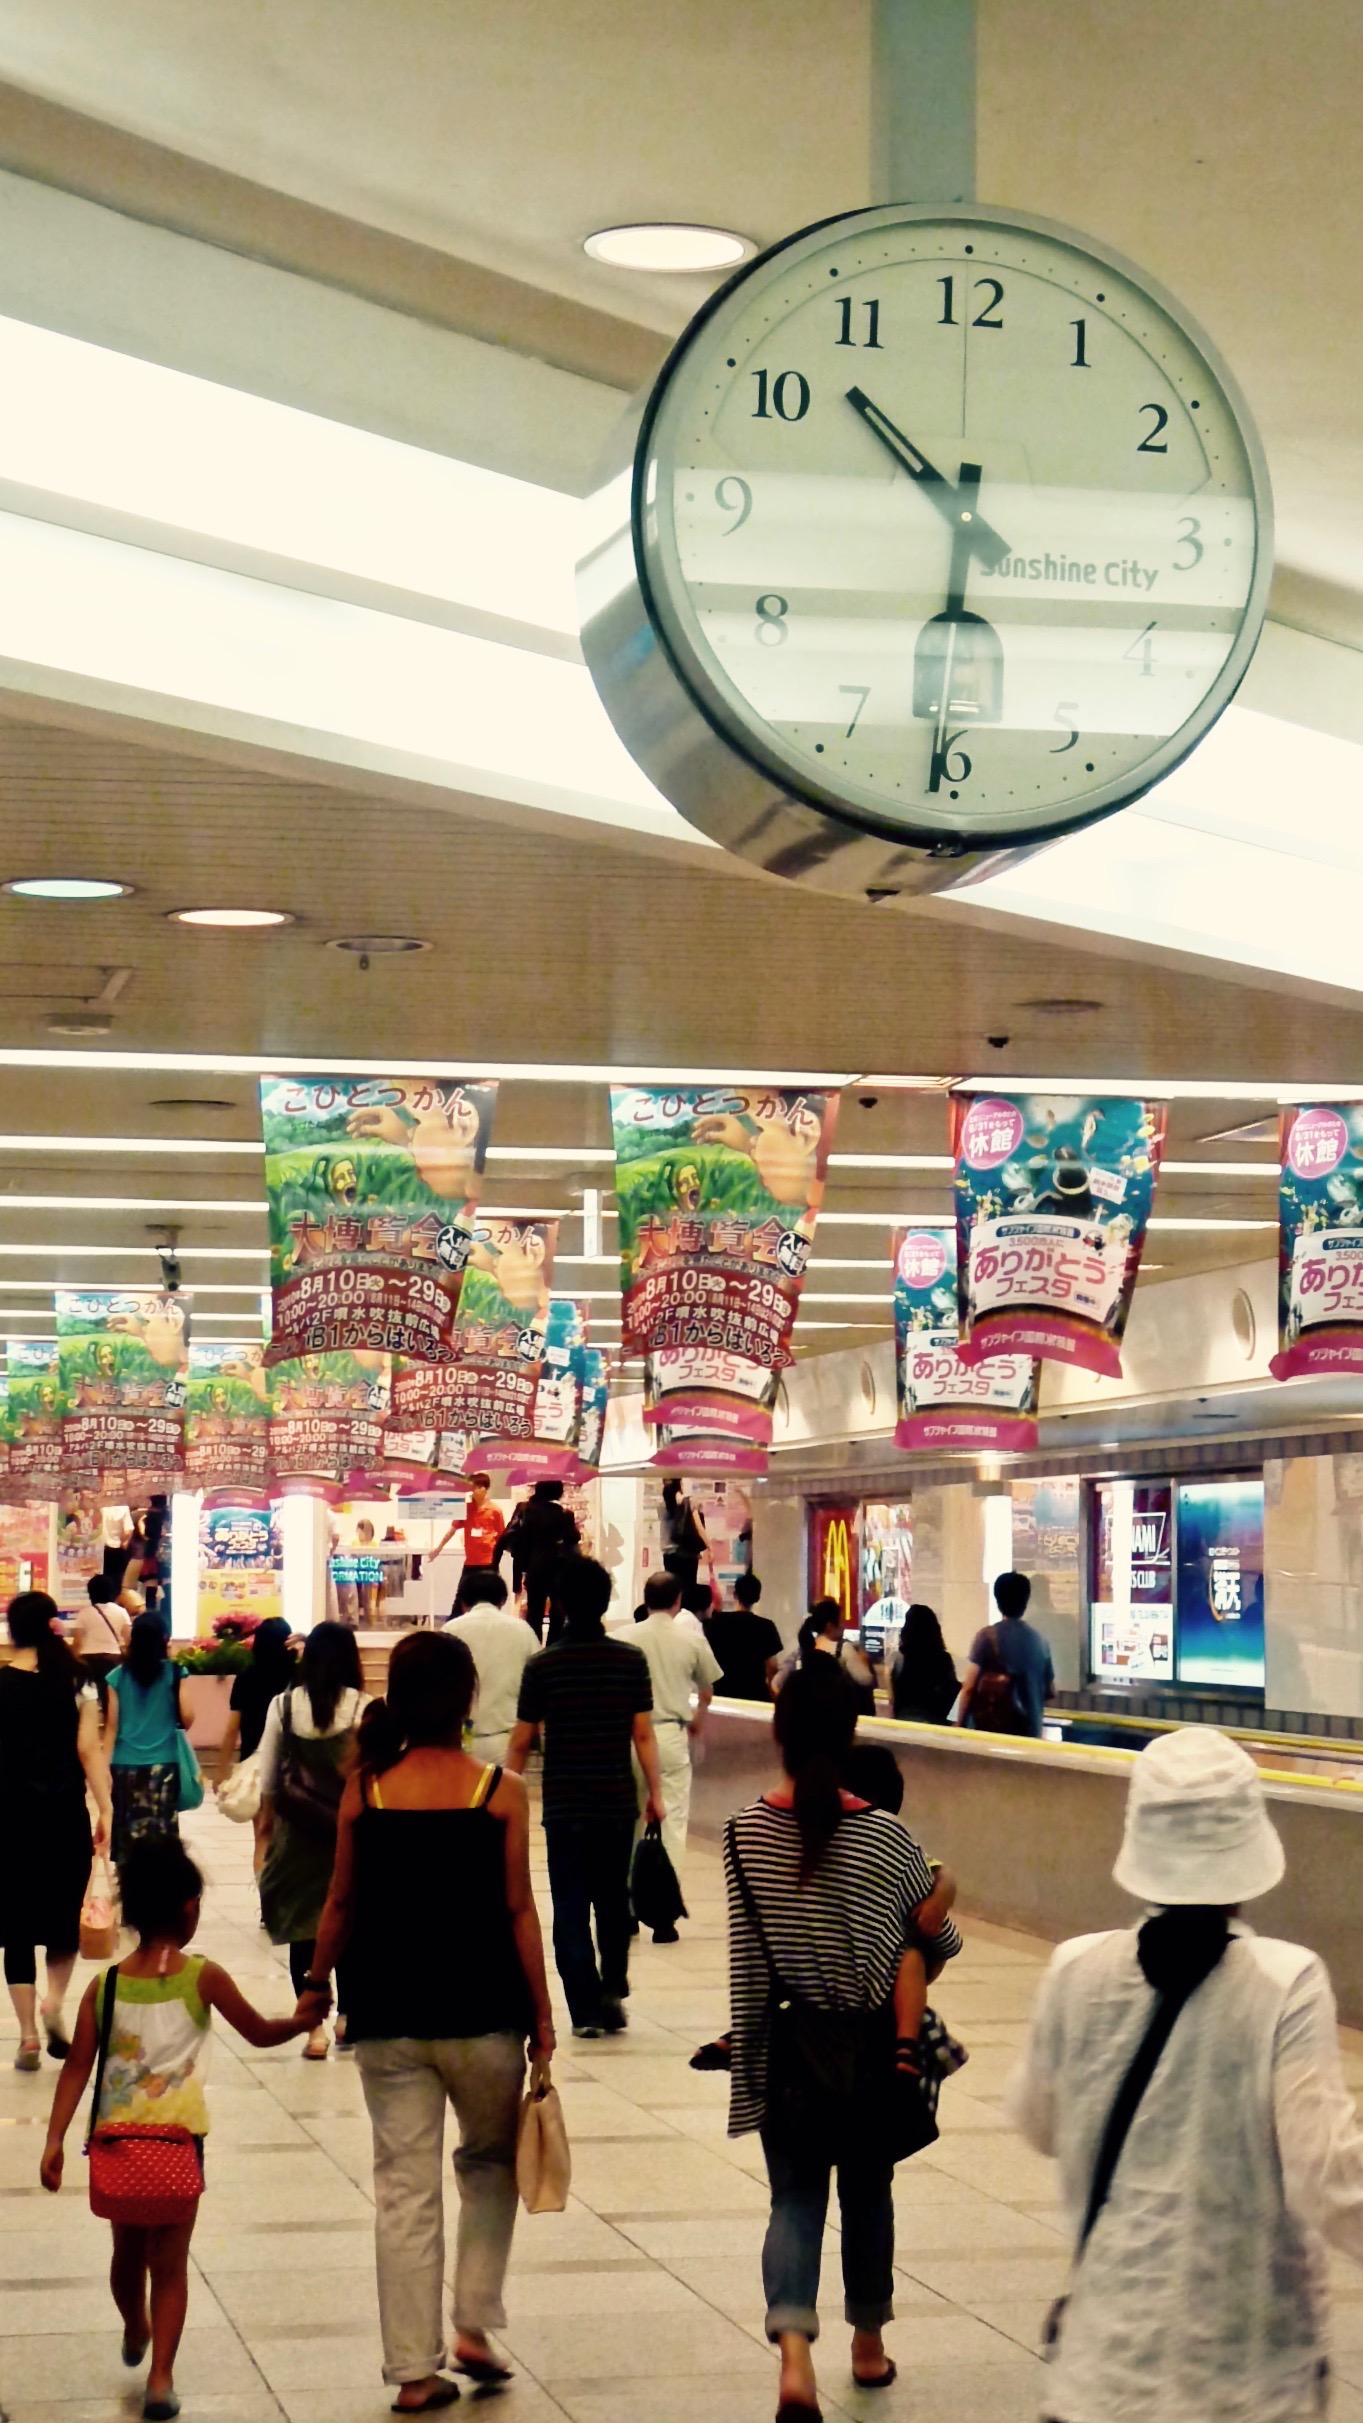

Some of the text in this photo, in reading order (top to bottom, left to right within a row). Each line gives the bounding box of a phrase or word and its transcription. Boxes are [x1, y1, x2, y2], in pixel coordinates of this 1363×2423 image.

[835, 297, 885, 349] 11
[937, 275, 1005, 329] 12
[1069, 318, 1092, 367] 1
[751, 368, 811, 422] 10
[1137, 403, 1169, 454] 2
[714, 476, 753, 536] 9
[1172, 516, 1205, 570] 3
[1104, 559, 1159, 592] City
[754, 593, 788, 646] 8
[1123, 620, 1159, 677] 4
[838, 684, 871, 738] 7
[1048, 701, 1080, 753] 5
[940, 729, 971, 782] 6
[969, 1128, 1014, 1158] 休館
[1295, 1138, 1339, 1167] 休館
[289, 1210, 445, 1263] 大博覧会
[473, 1226, 541, 1248] つかん
[638, 1215, 787, 1266] 大博覧会
[904, 1258, 940, 1277] 休館
[974, 1245, 1106, 1285] ありがとう
[996, 1276, 1072, 1298] フェスタ
[1324, 1292, 1363, 1311] フェ
[679, 1365, 736, 1381] フェスタ
[933, 1380, 990, 1396] フェスタ
[331, 1571, 384, 1582] ORMATION
